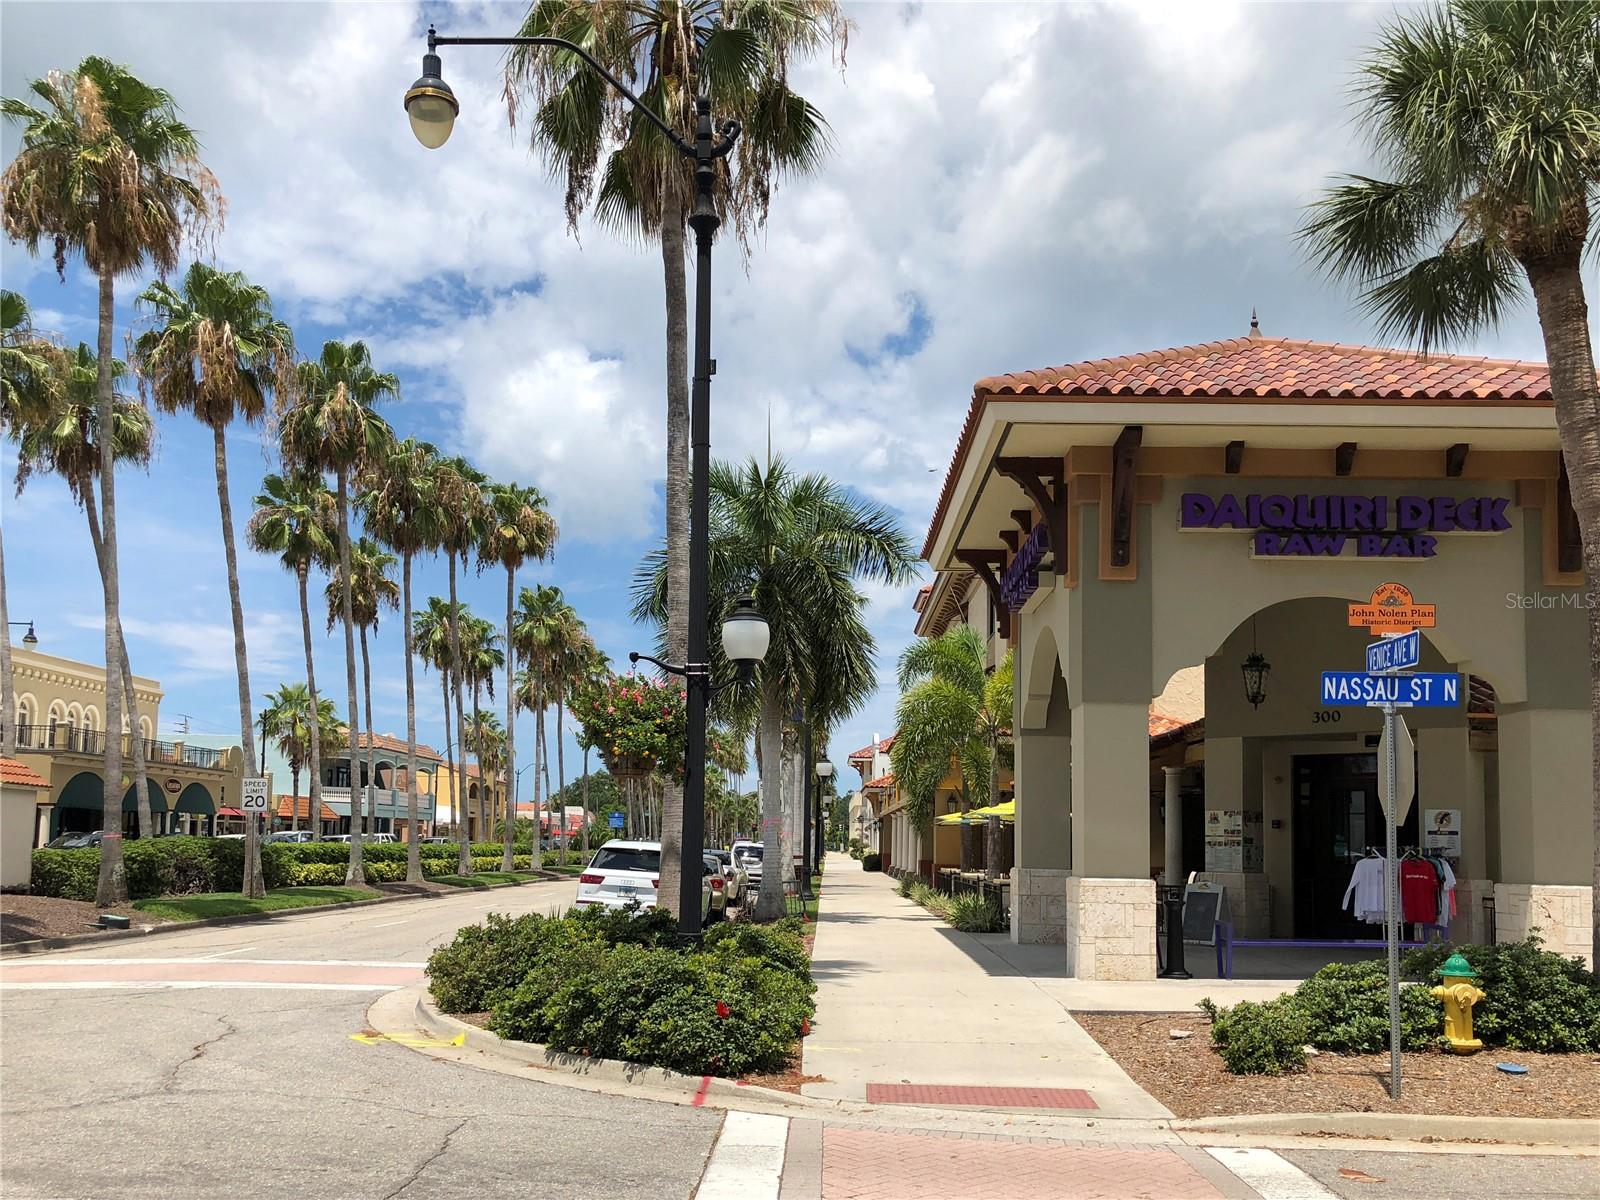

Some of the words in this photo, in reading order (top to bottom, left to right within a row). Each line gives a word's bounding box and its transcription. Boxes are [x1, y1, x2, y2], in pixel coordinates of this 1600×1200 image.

[1181, 493, 1388, 531] DAIQUIRI
[1396, 496, 1512, 532] DECK
[1254, 533, 1345, 556] RAW
[1357, 534, 1438, 557] BAR
[1350, 609, 1375, 617] John
[1378, 609, 1407, 617] Nolen
[1410, 609, 1434, 617] Plan
[1394, 618, 1422, 626] District
[1369, 643, 1391, 670] VENICE
[1393, 638, 1407, 665] AVE
[1410, 635, 1416, 660] W
[1324, 677, 1399, 701] NASSAU
[1410, 678, 1433, 701] ST
[1444, 679, 1457, 702] N
[1311, 710, 1341, 724] 300
[244, 795, 265, 808] 20
